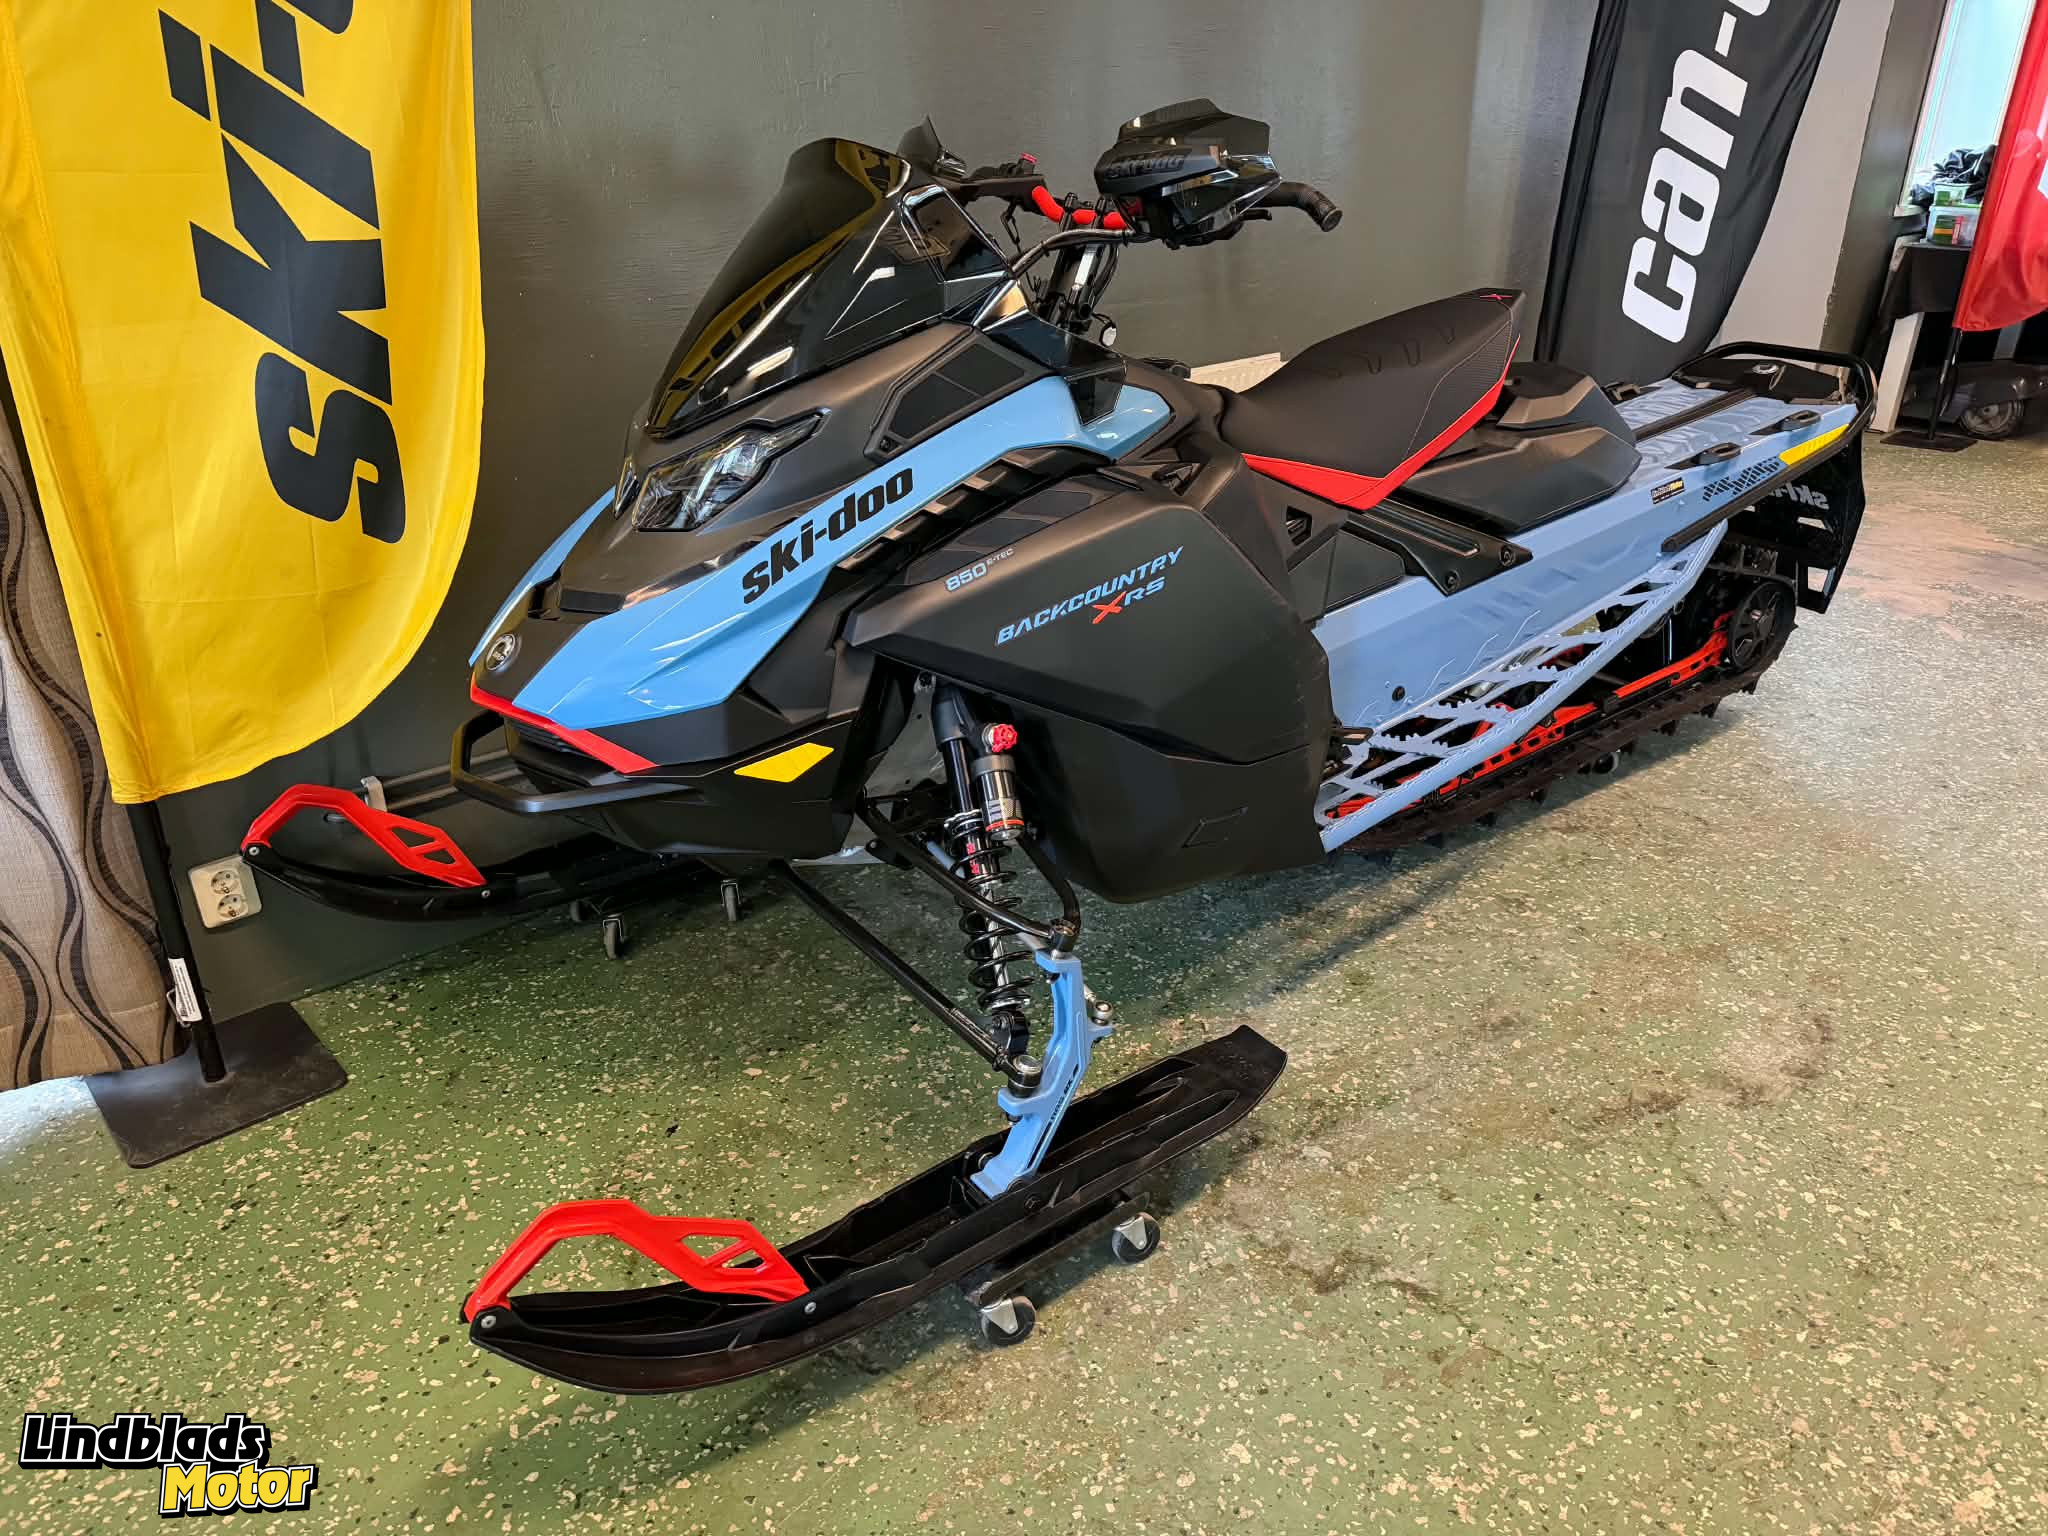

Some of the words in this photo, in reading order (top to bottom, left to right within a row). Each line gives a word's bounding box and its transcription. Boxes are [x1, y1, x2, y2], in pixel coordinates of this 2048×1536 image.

[158, 0, 406, 544] ski-
[1621, 0, 1770, 343] can-
[945, 562, 988, 592] 850
[996, 545, 1184, 646] BACKCOUNTRY
